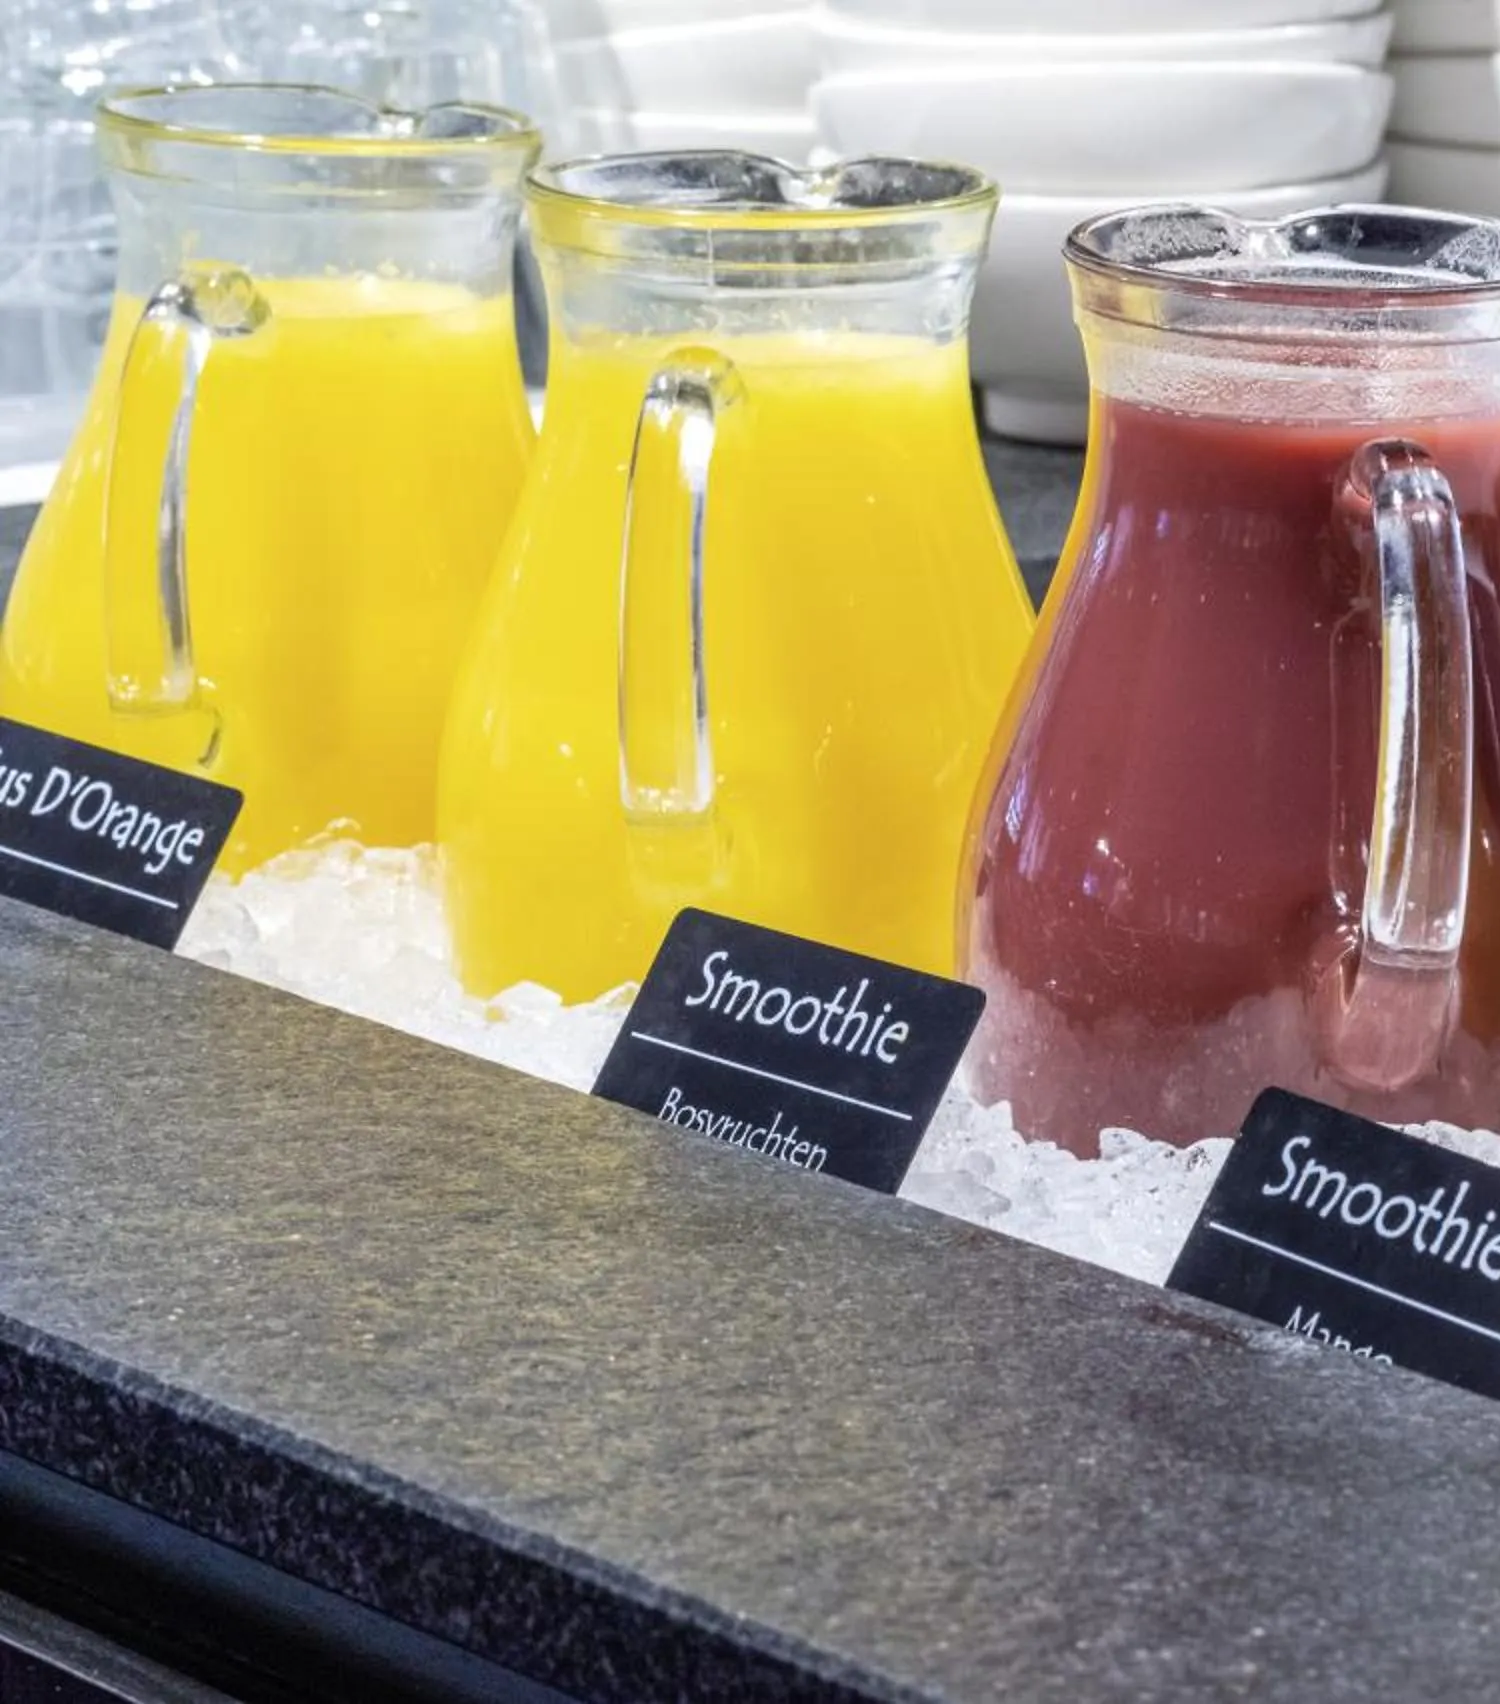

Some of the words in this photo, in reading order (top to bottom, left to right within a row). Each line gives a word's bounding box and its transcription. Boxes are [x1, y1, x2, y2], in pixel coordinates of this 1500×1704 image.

[0, 746, 33, 807] us
[30, 766, 205, 875] D'Orange
[685, 950, 909, 1064] Smoothie
[656, 1086, 829, 1172] Bosvruchten
